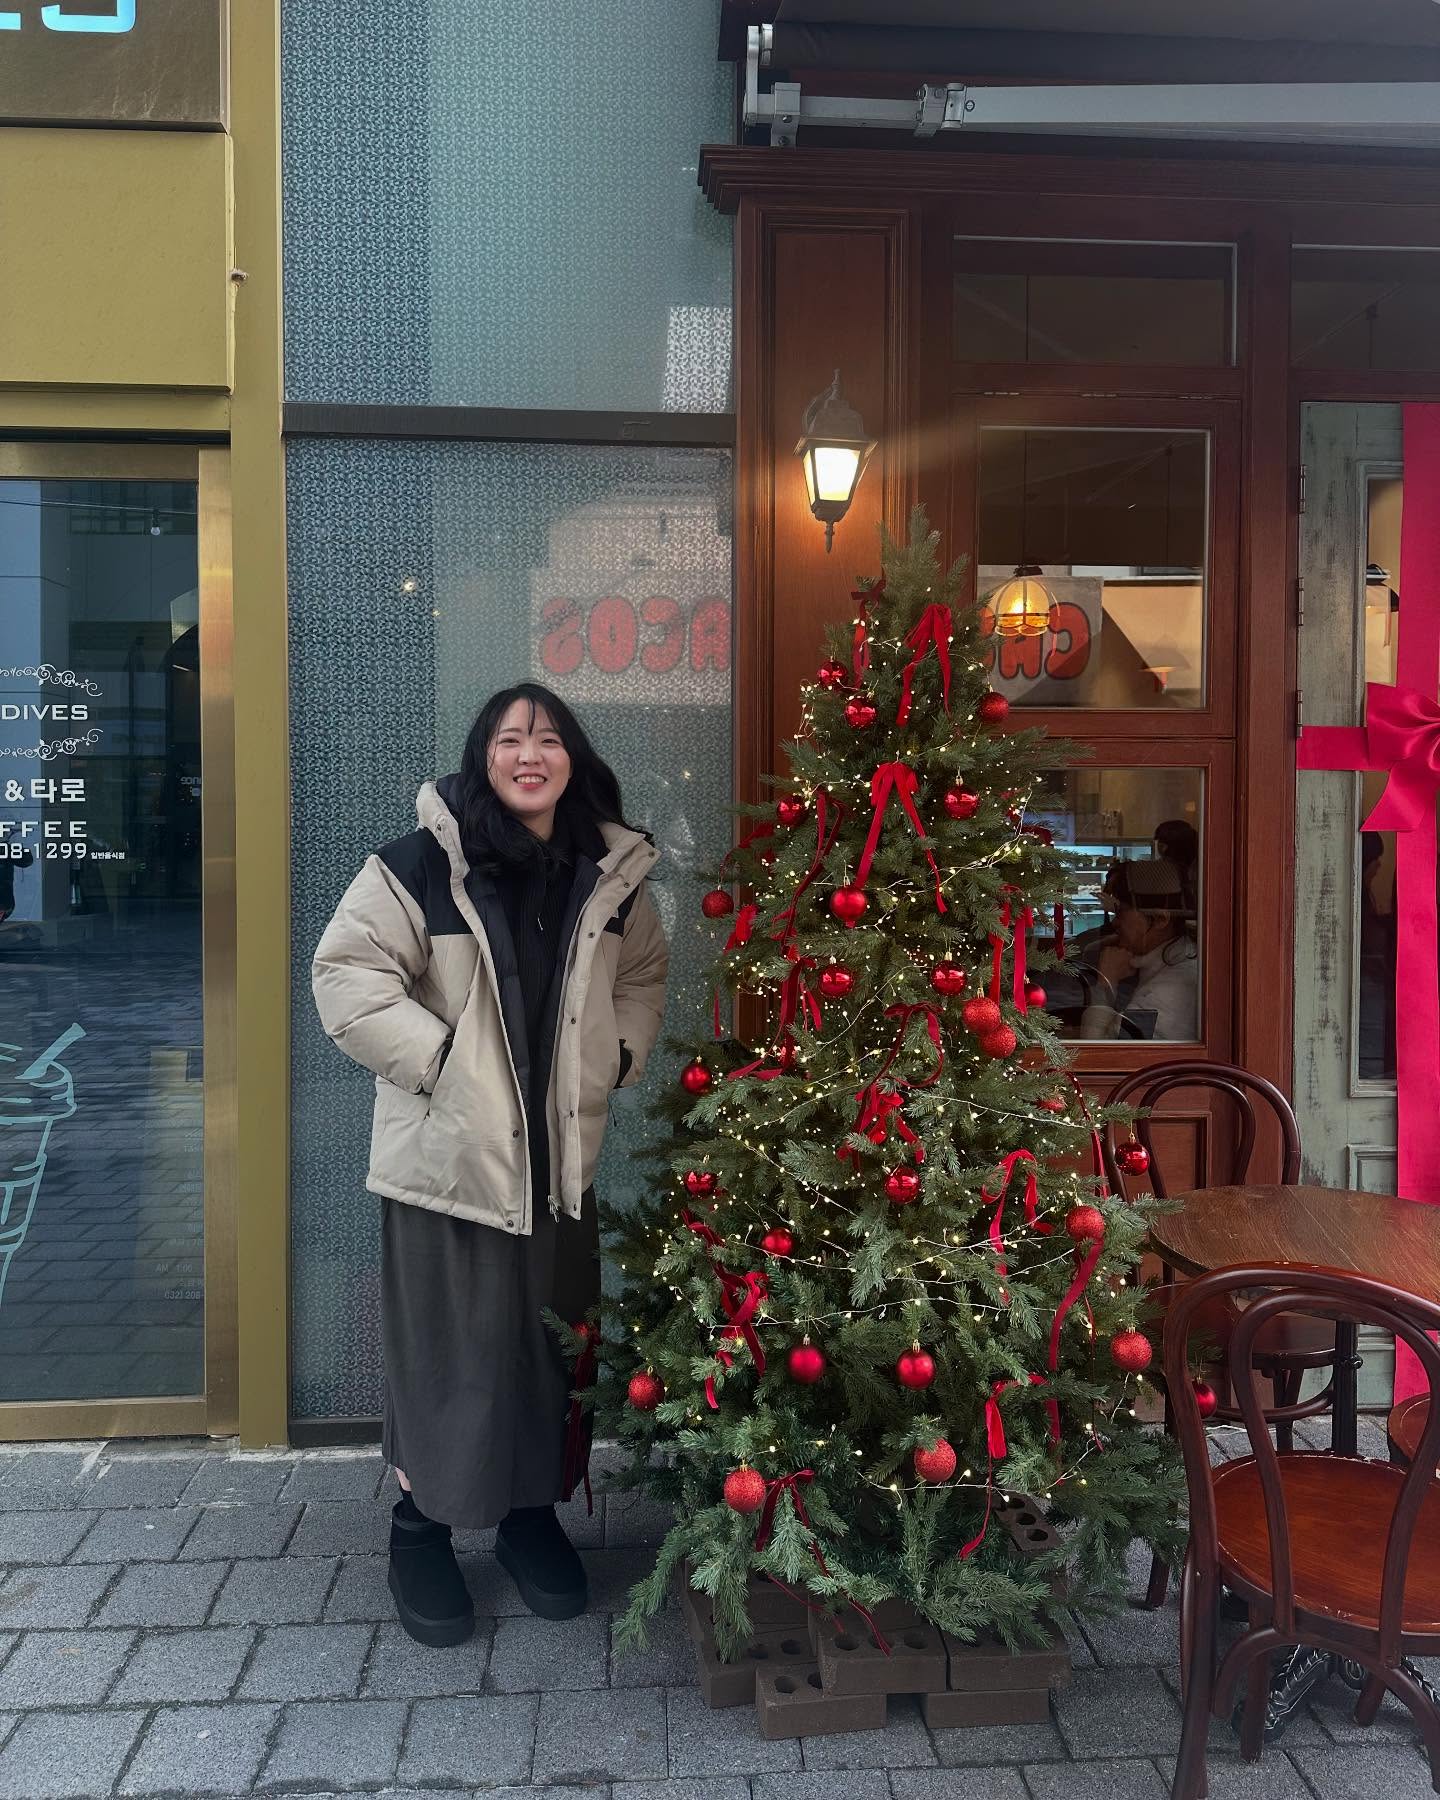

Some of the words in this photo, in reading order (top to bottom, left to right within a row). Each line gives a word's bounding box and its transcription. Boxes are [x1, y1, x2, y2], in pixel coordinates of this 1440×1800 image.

[1, 704, 89, 721] DIVES
[5, 779, 25, 802] &
[30, 778, 86, 804] 타로
